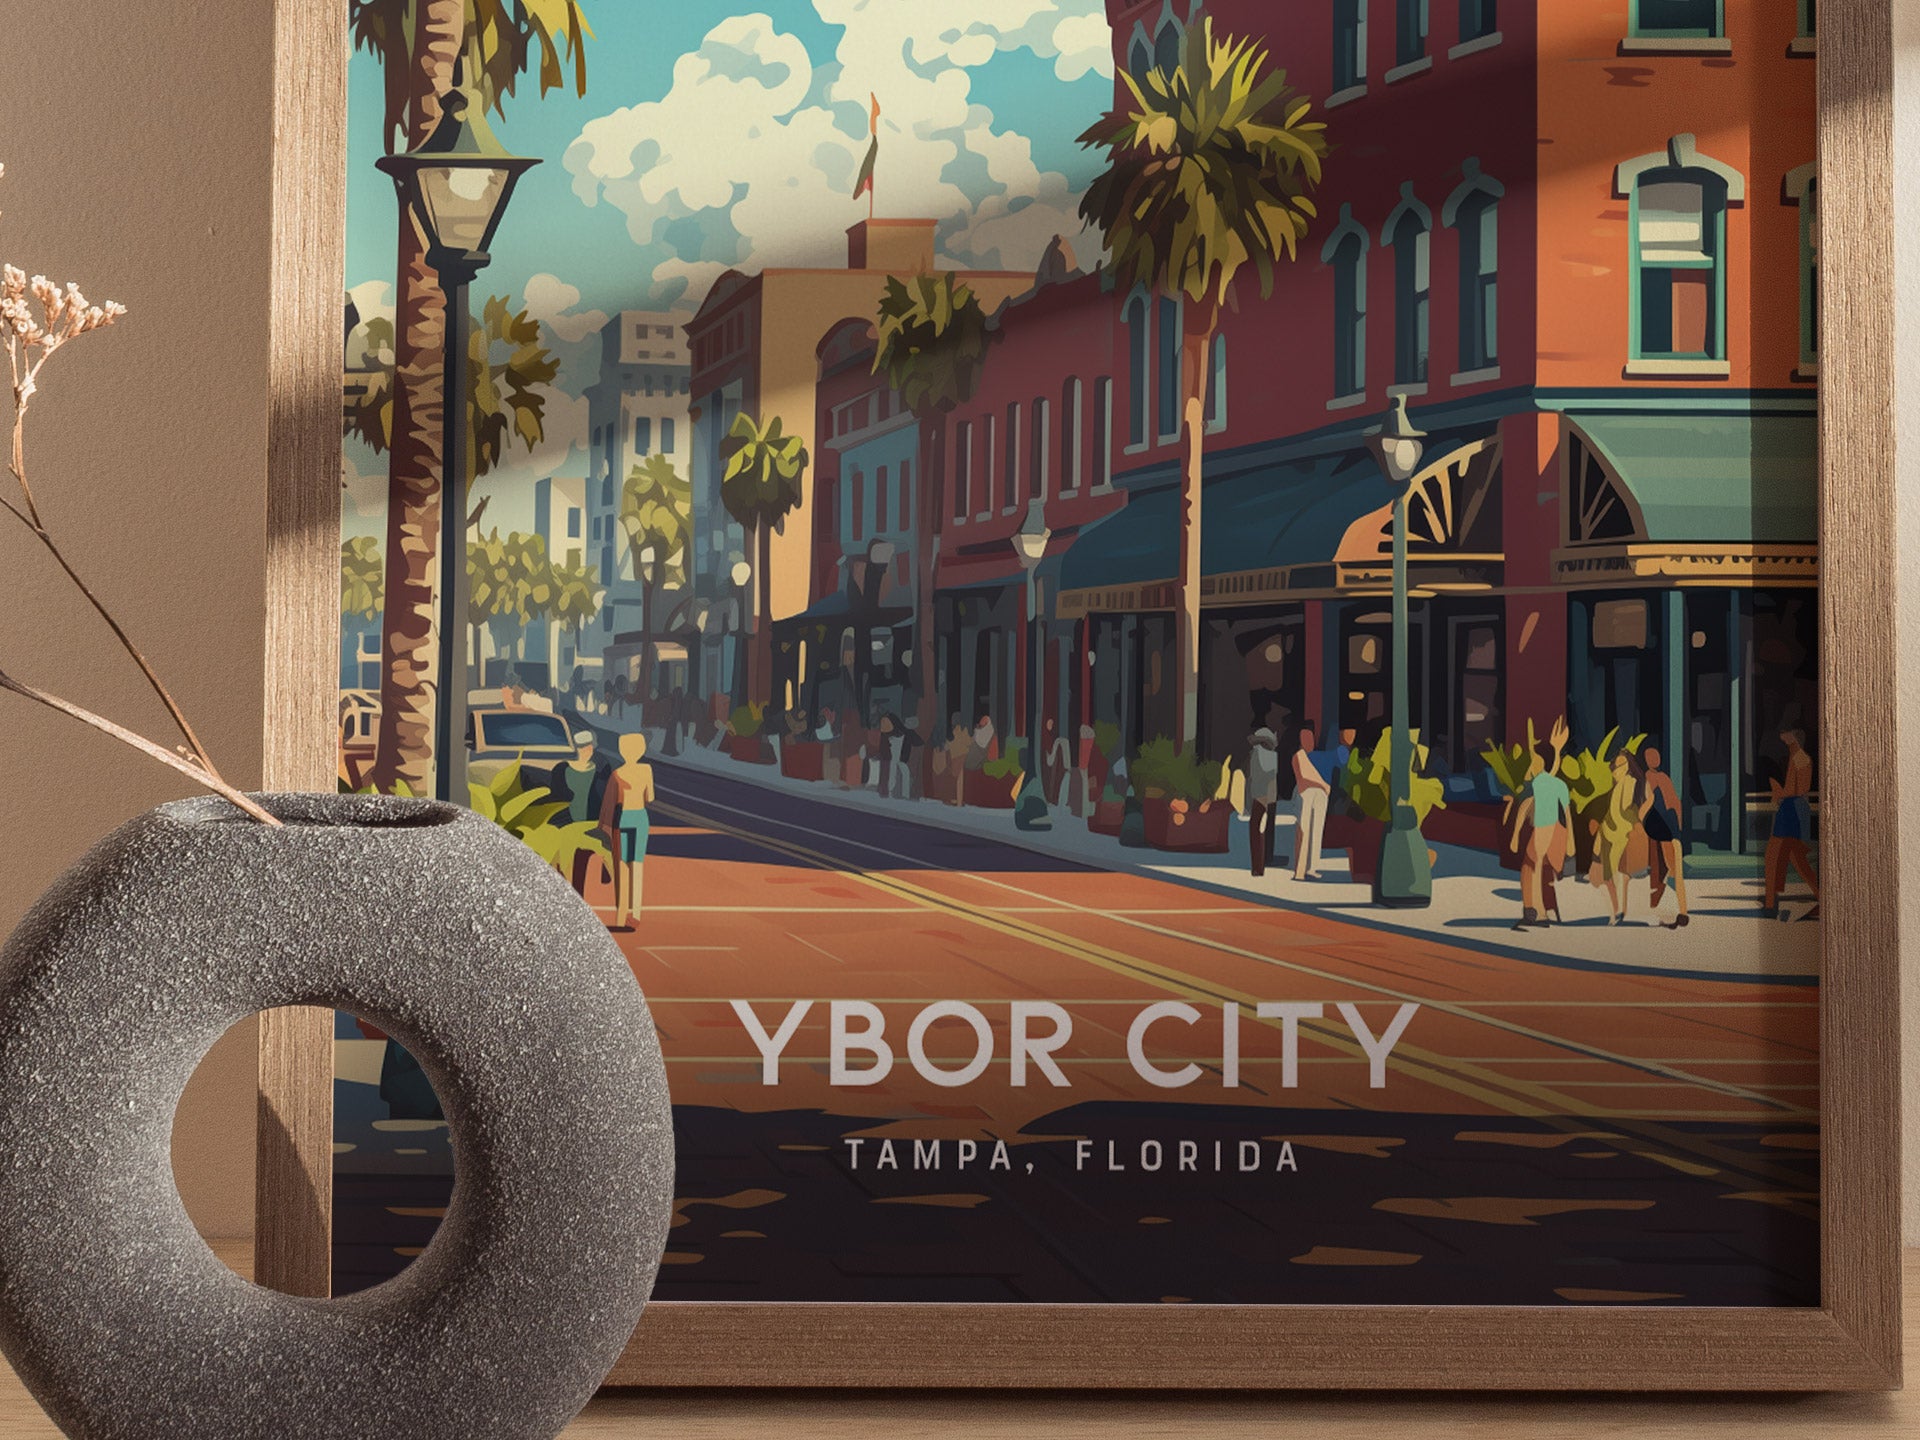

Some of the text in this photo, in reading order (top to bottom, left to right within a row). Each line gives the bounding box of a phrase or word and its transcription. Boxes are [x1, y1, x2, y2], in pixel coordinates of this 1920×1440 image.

[730, 999, 1421, 1089] YBOR CITY
[845, 1138, 1299, 1174] TAMPA, FLORIDA
